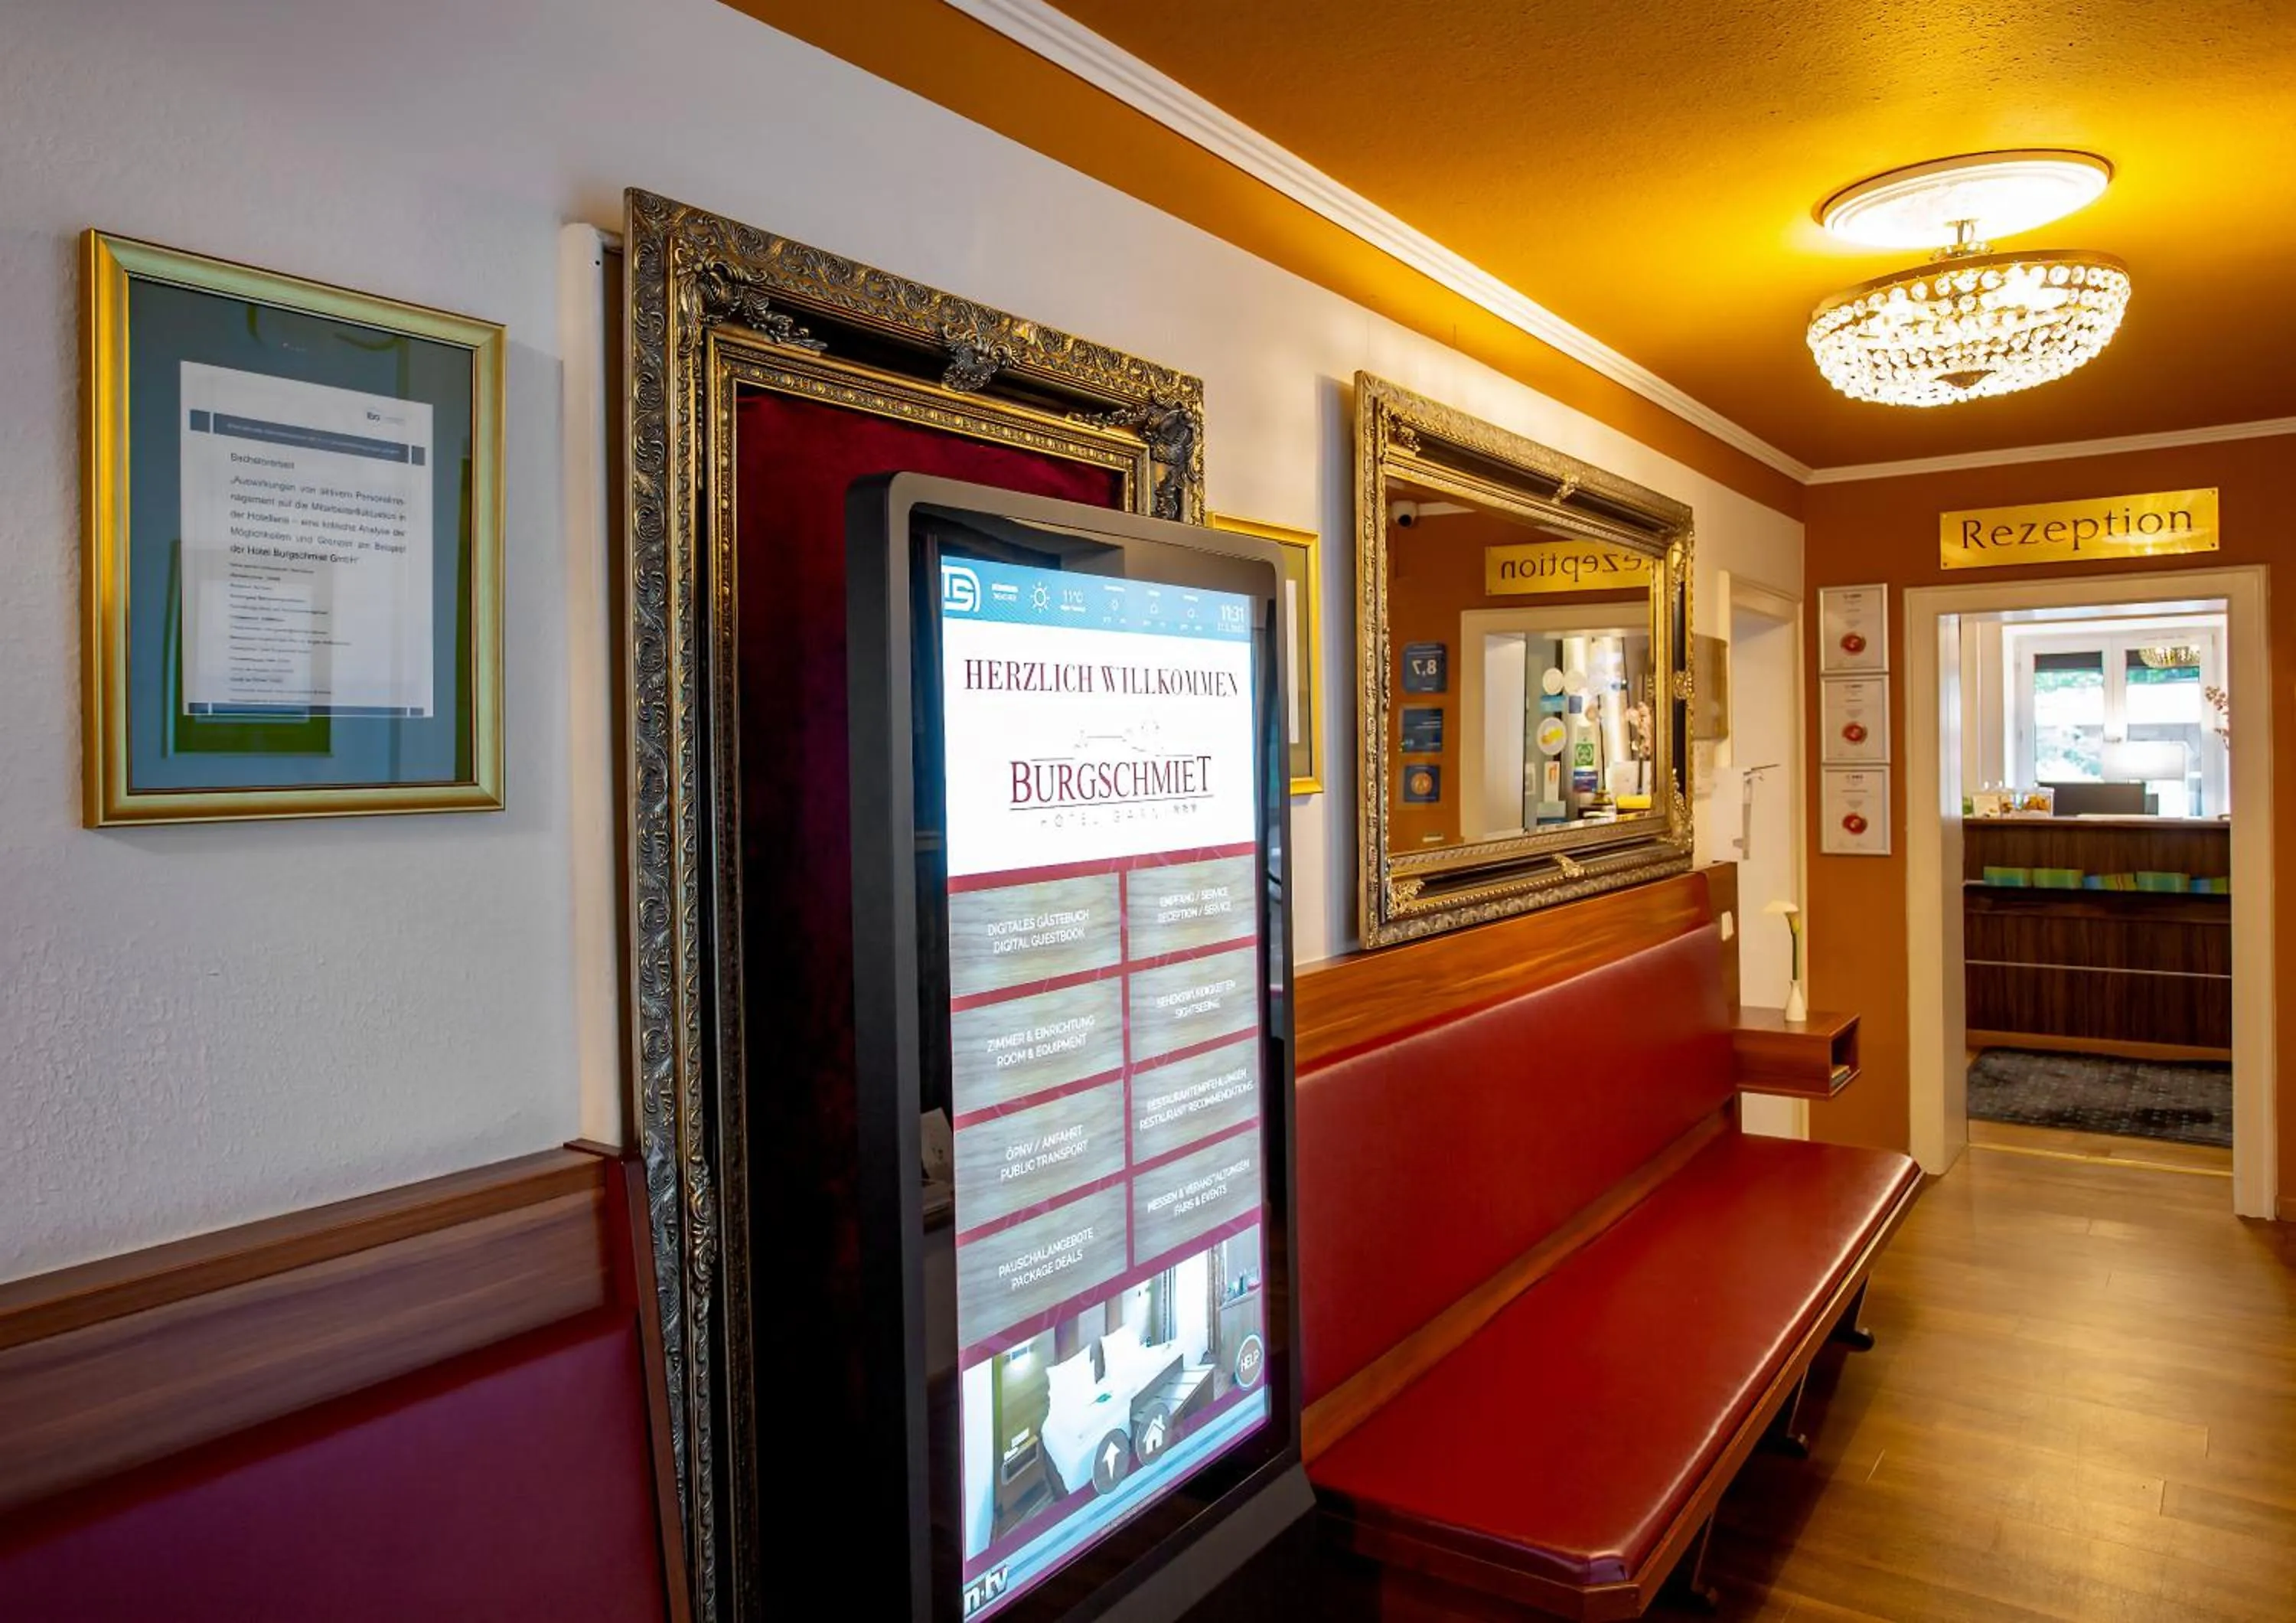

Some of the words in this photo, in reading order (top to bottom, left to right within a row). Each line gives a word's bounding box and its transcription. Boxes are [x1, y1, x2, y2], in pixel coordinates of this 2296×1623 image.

[1962, 507, 2193, 550] Rezeption
[964, 659, 1093, 693] HERZLICH
[1101, 665, 1238, 697] WILLKOMMEN
[1009, 756, 1212, 804] BURGSCHMIET
[987, 917, 1035, 937] DIGITALES
[1038, 909, 1090, 929] GÄSTEBUCH
[993, 936, 1030, 955] DIGITAL
[1031, 926, 1086, 948] GUESTBOOK
[987, 1032, 1026, 1053] ZIMMER
[1035, 1014, 1096, 1040] EINRICHTUNG
[996, 1047, 1026, 1067] ROOM
[1035, 1033, 1088, 1058] EQUIPMENT
[1000, 1160, 1035, 1183] PUBLIC
[1035, 1139, 1090, 1169] TRANSPORT
[999, 1227, 1094, 1278] PAUSCHALANGEBOTE
[1011, 1261, 1054, 1291] PACKAGE
[1055, 1249, 1084, 1272] DEALS
[1240, 1351, 1260, 1373] HELP
